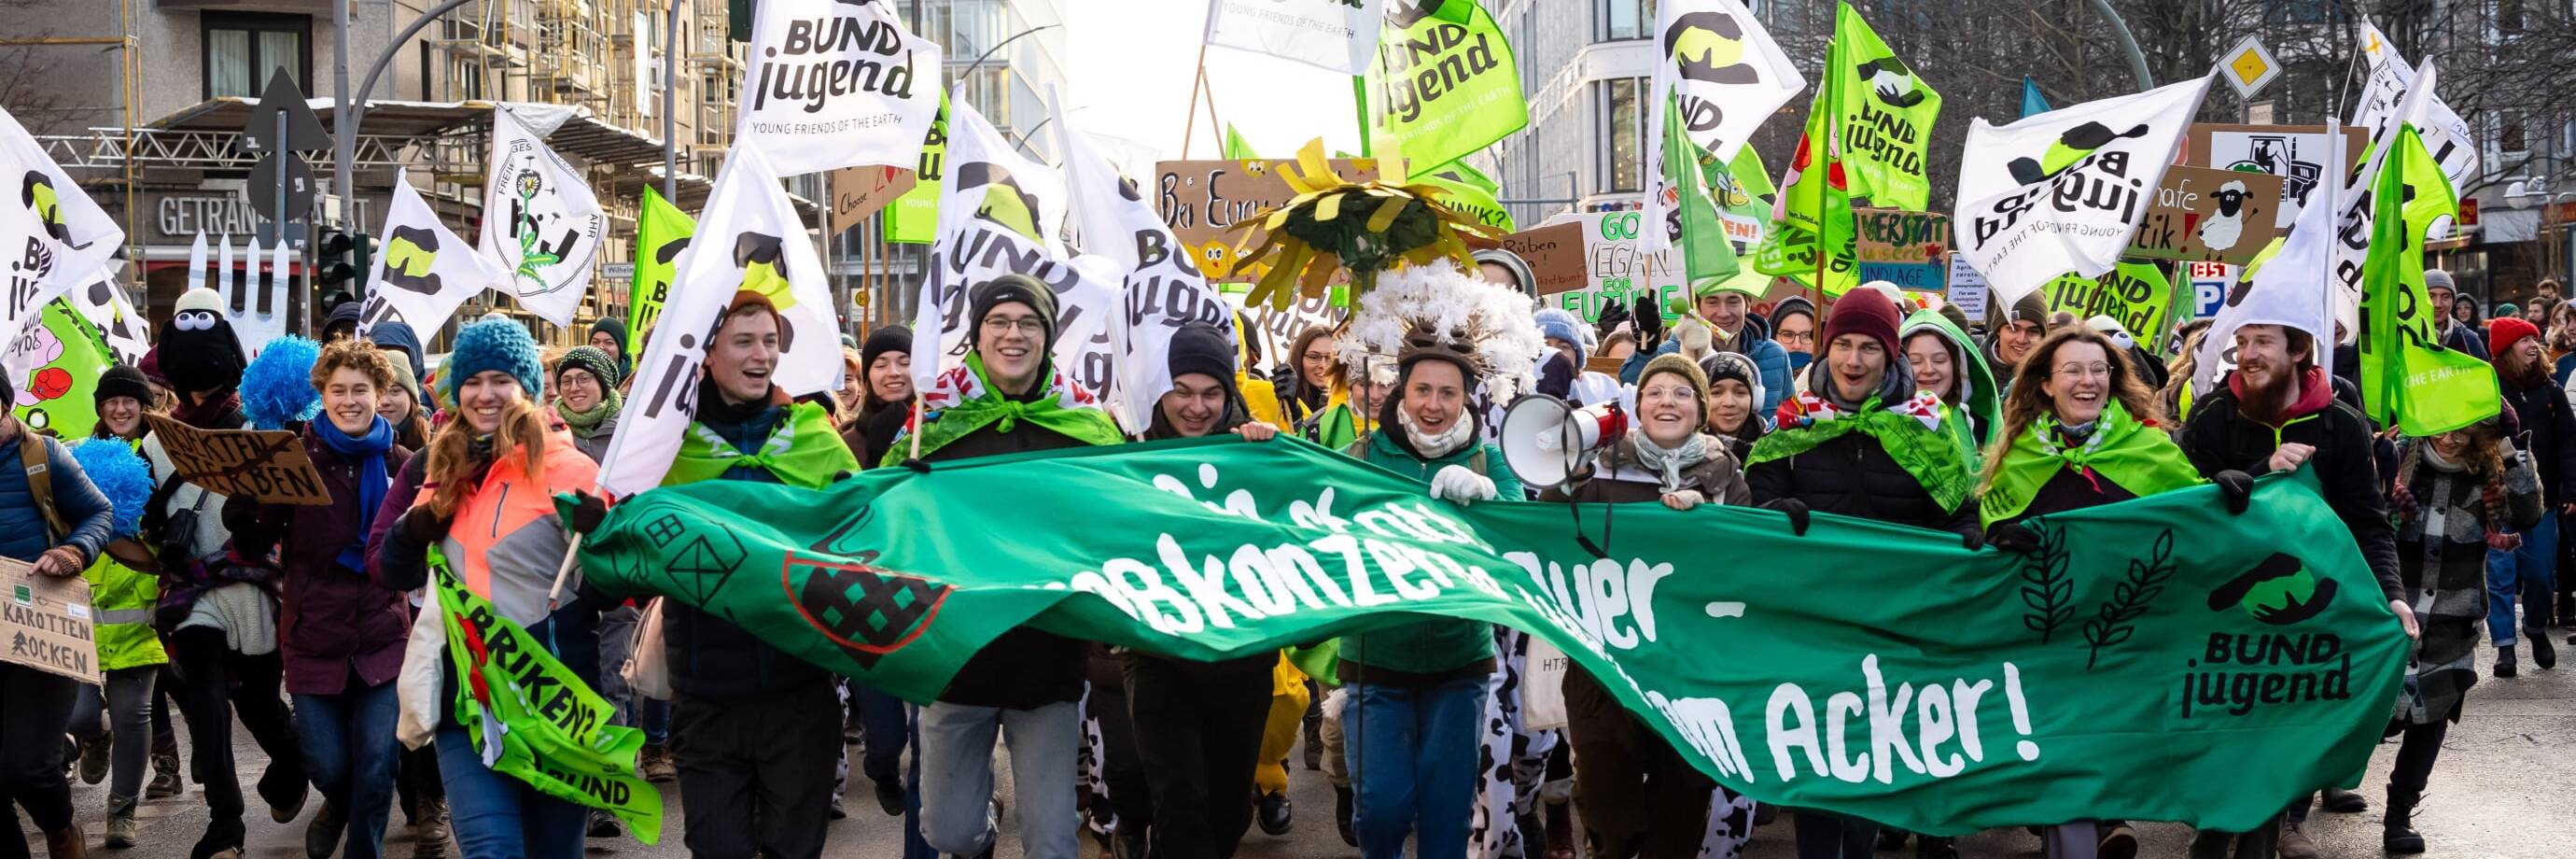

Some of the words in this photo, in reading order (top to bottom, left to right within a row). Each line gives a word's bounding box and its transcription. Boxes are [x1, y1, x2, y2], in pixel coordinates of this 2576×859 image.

[783, 17, 902, 56] BUND
[1258, 9, 1295, 27] FRIENDS
[1324, 22, 1355, 40] EARTH
[753, 47, 914, 113] jugend
[752, 122, 791, 134] YOUNG
[794, 121, 835, 135] FRIENDS
[838, 119, 849, 132] OF
[851, 116, 872, 129] THE
[874, 113, 903, 127] EARTH
[840, 192, 867, 216] Choose
[1158, 172, 1195, 230] Bei
[1601, 211, 1641, 241] GO
[1586, 242, 1673, 278] VEGAN
[1863, 246, 1925, 261] unsere
[1603, 279, 1633, 291] FOR
[2194, 284, 2221, 316] P
[155, 420, 272, 462] INSEKTEN
[3, 601, 91, 641] KAROTTEN
[2204, 632, 2342, 666] BUND
[2181, 652, 2351, 719] jugend
[1766, 654, 2040, 784] Acker!
